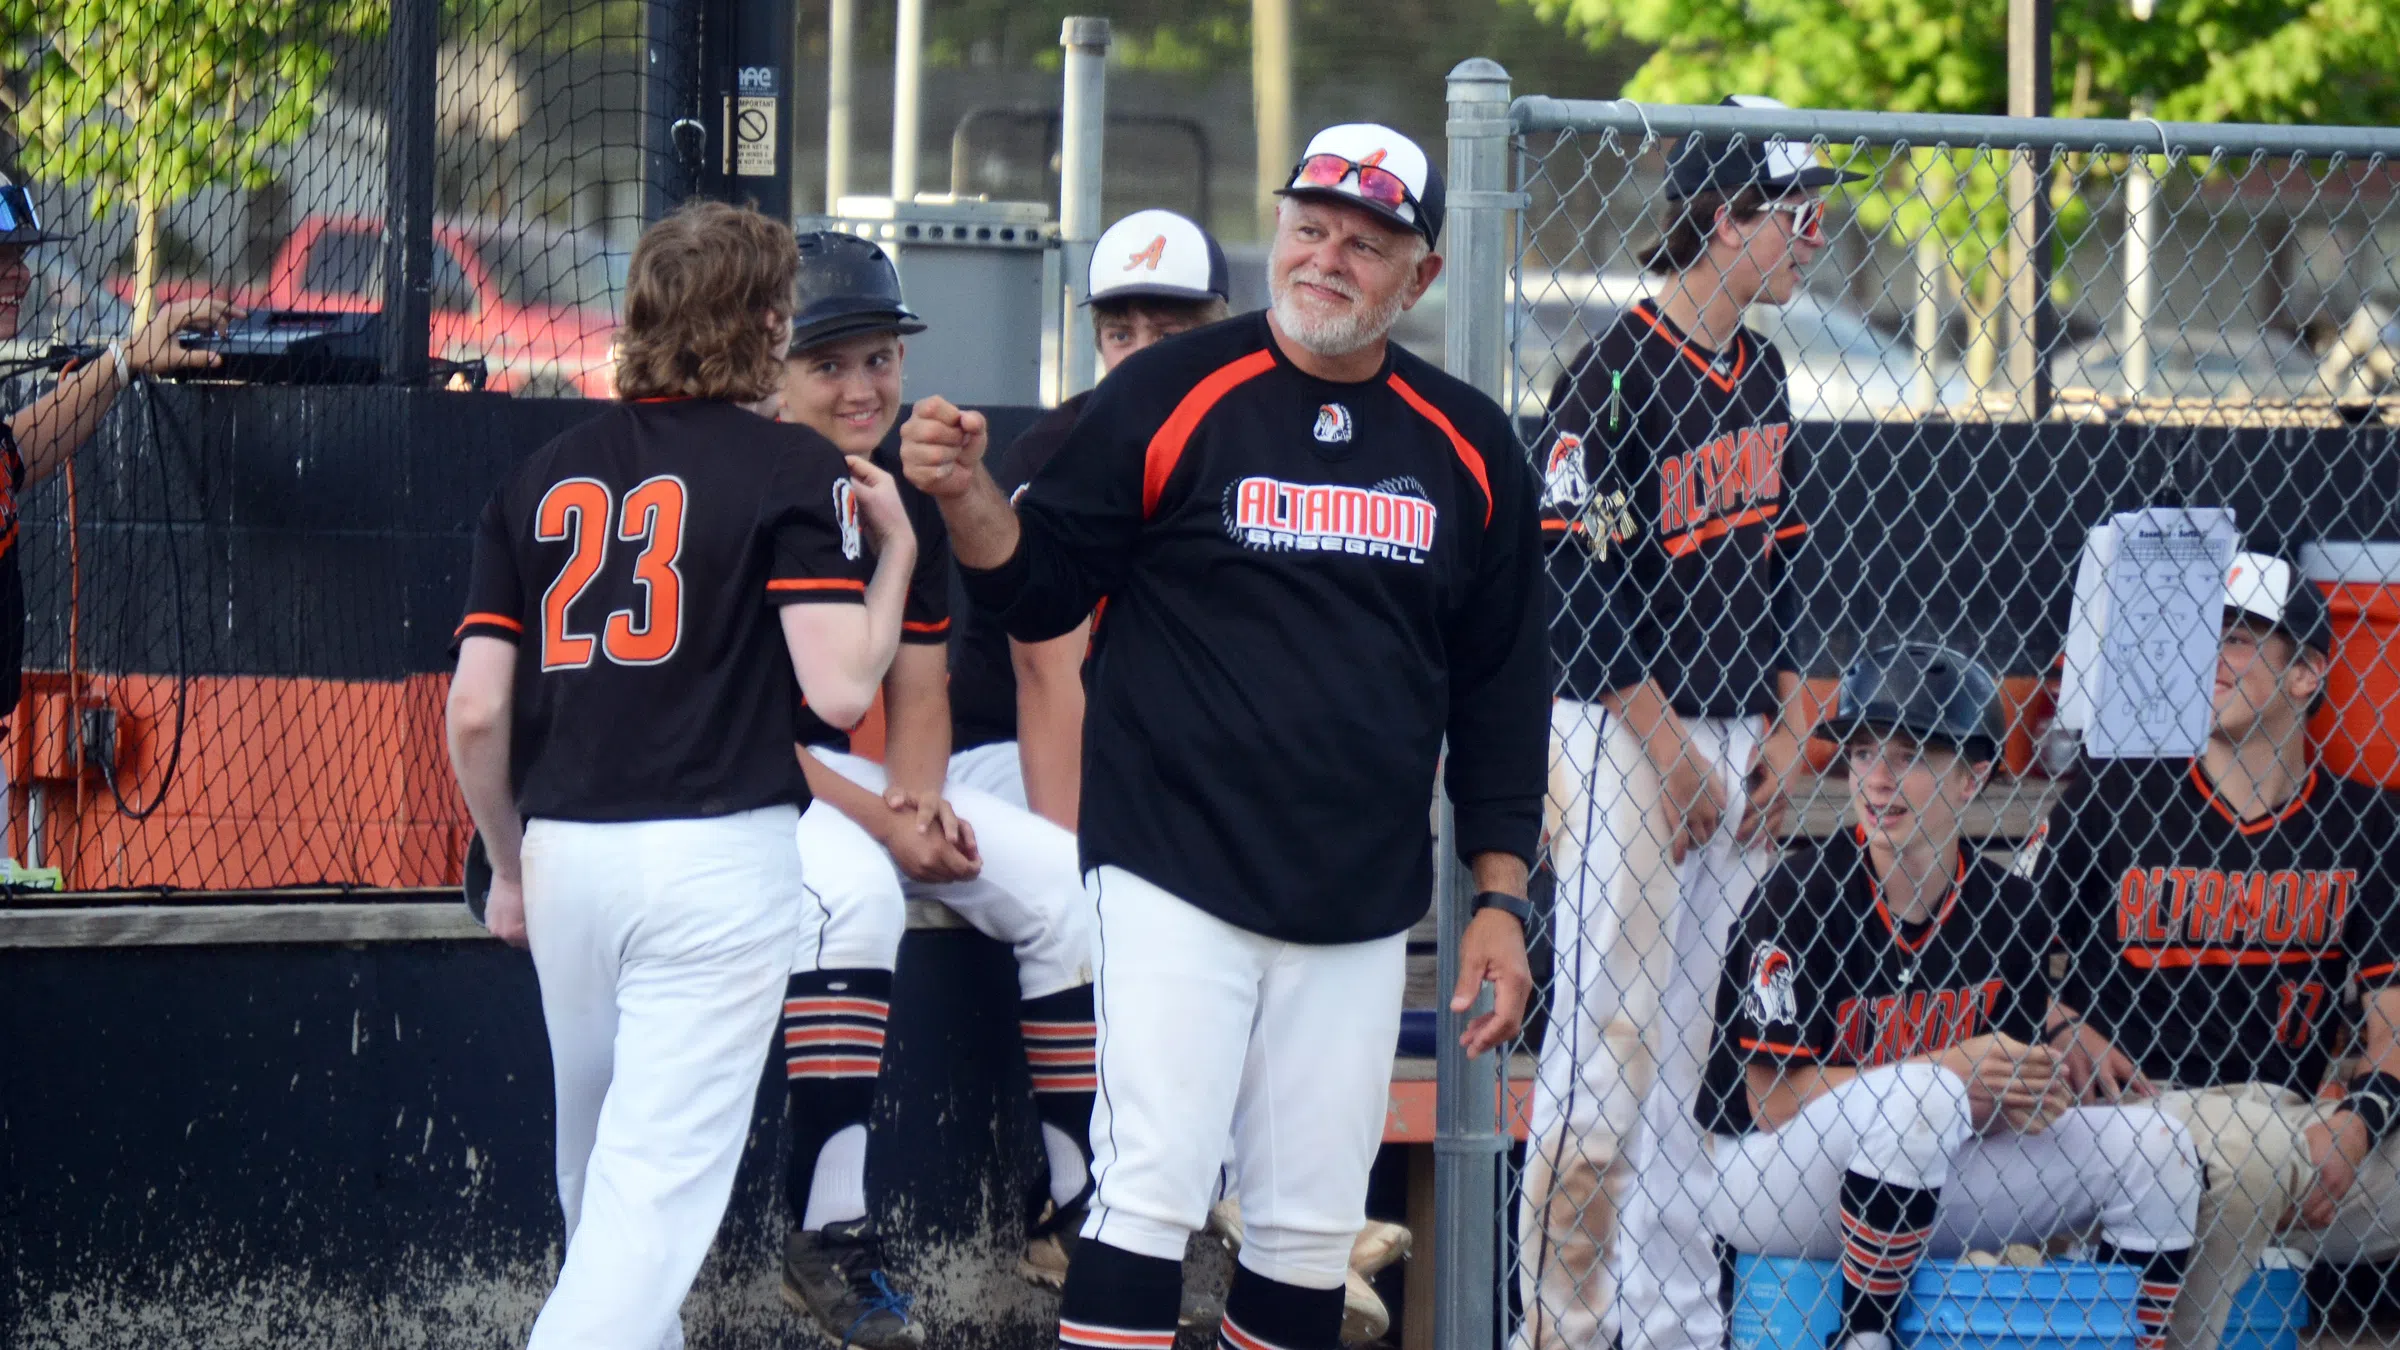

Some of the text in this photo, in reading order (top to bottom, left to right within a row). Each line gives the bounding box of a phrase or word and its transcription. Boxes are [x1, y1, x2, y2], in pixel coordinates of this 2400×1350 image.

[739, 99, 774, 108] MPORTANT
[1122, 234, 1167, 271] A
[1236, 476, 1438, 552] ALTAMONT
[1246, 528, 1426, 565] BASEBALL
[534, 474, 688, 673] 23
[2116, 866, 2357, 944] ALTAMONT
[2276, 979, 2325, 1047] 17
